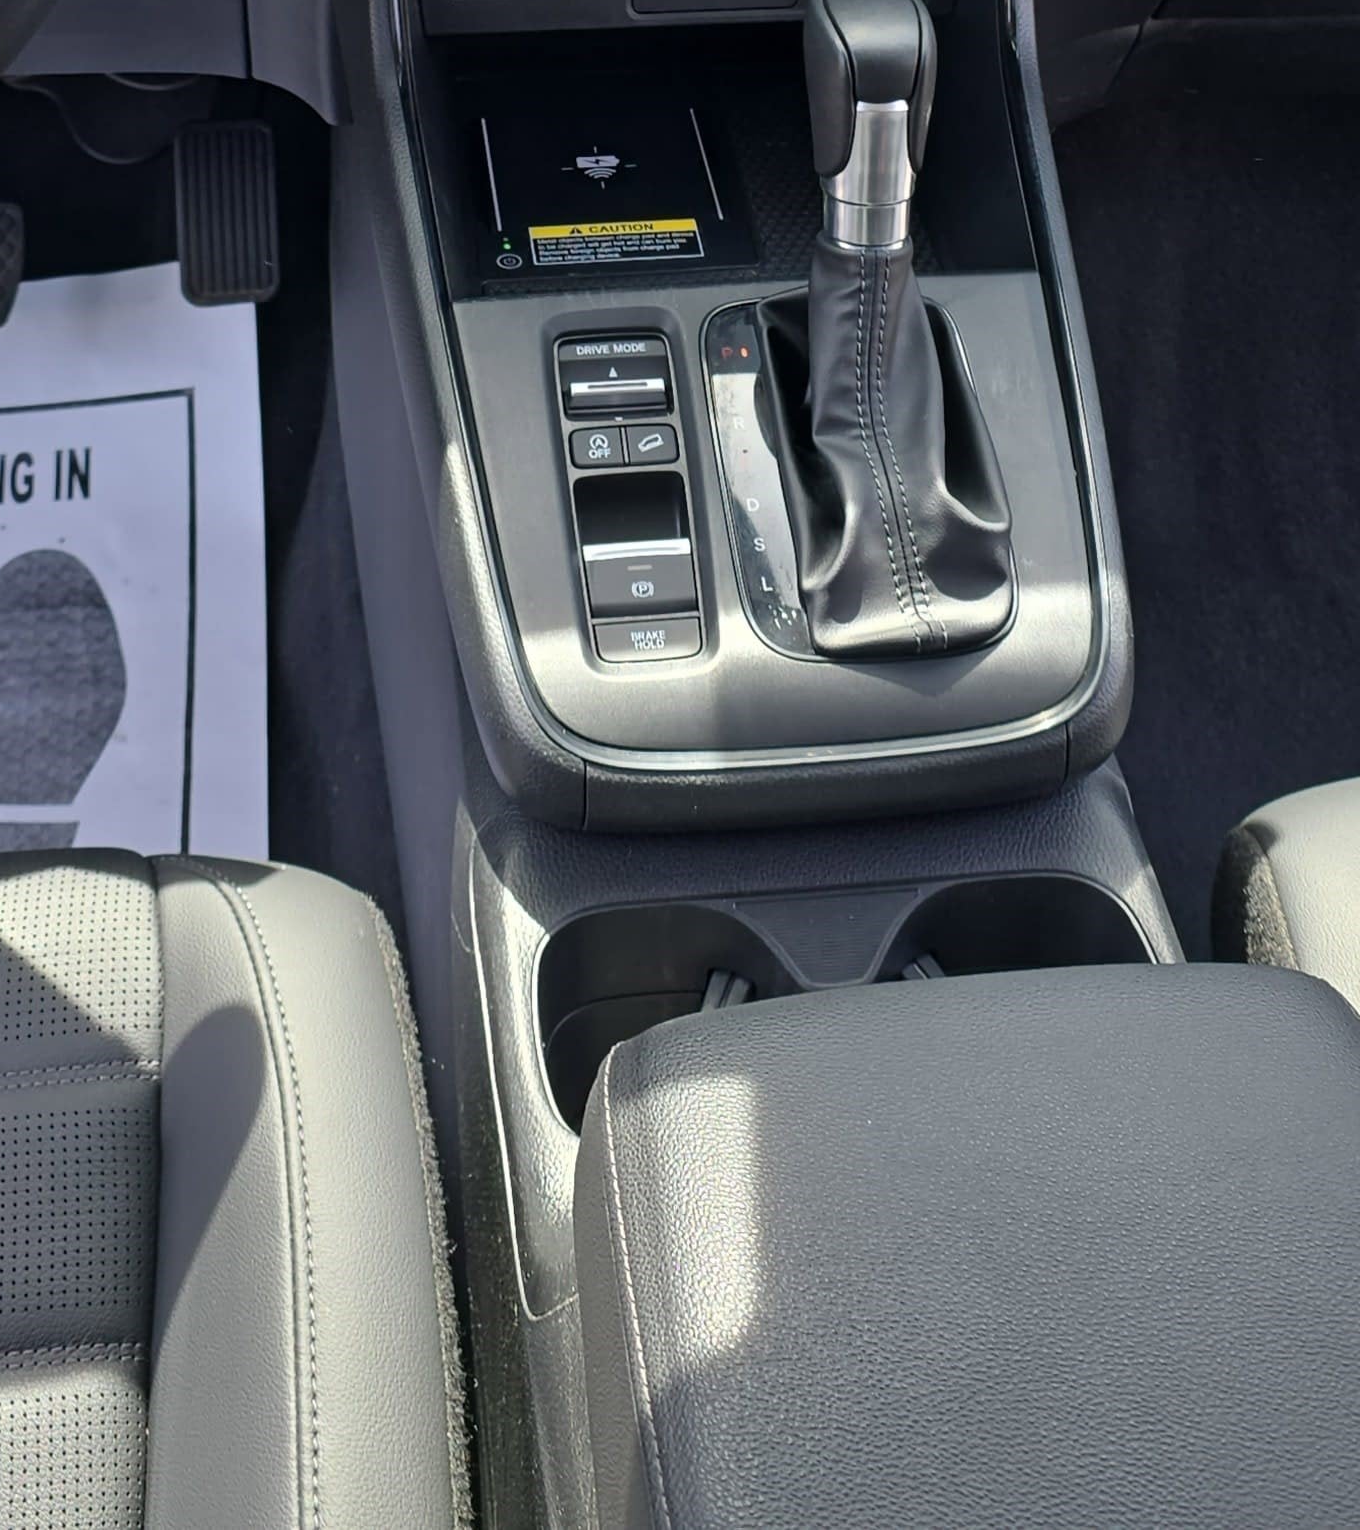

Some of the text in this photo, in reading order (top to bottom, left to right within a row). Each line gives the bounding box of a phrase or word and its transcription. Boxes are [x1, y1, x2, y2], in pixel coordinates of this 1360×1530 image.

[588, 223, 654, 234] CAUTION
[576, 342, 647, 356] DRIVE MODE
[588, 449, 611, 460] OFF
[53, 447, 93, 501] IN
[747, 498, 760, 512] D
[754, 538, 766, 552] S
[760, 577, 773, 592] L
[630, 630, 666, 642] BRAKE
[634, 639, 665, 651] HOLD
